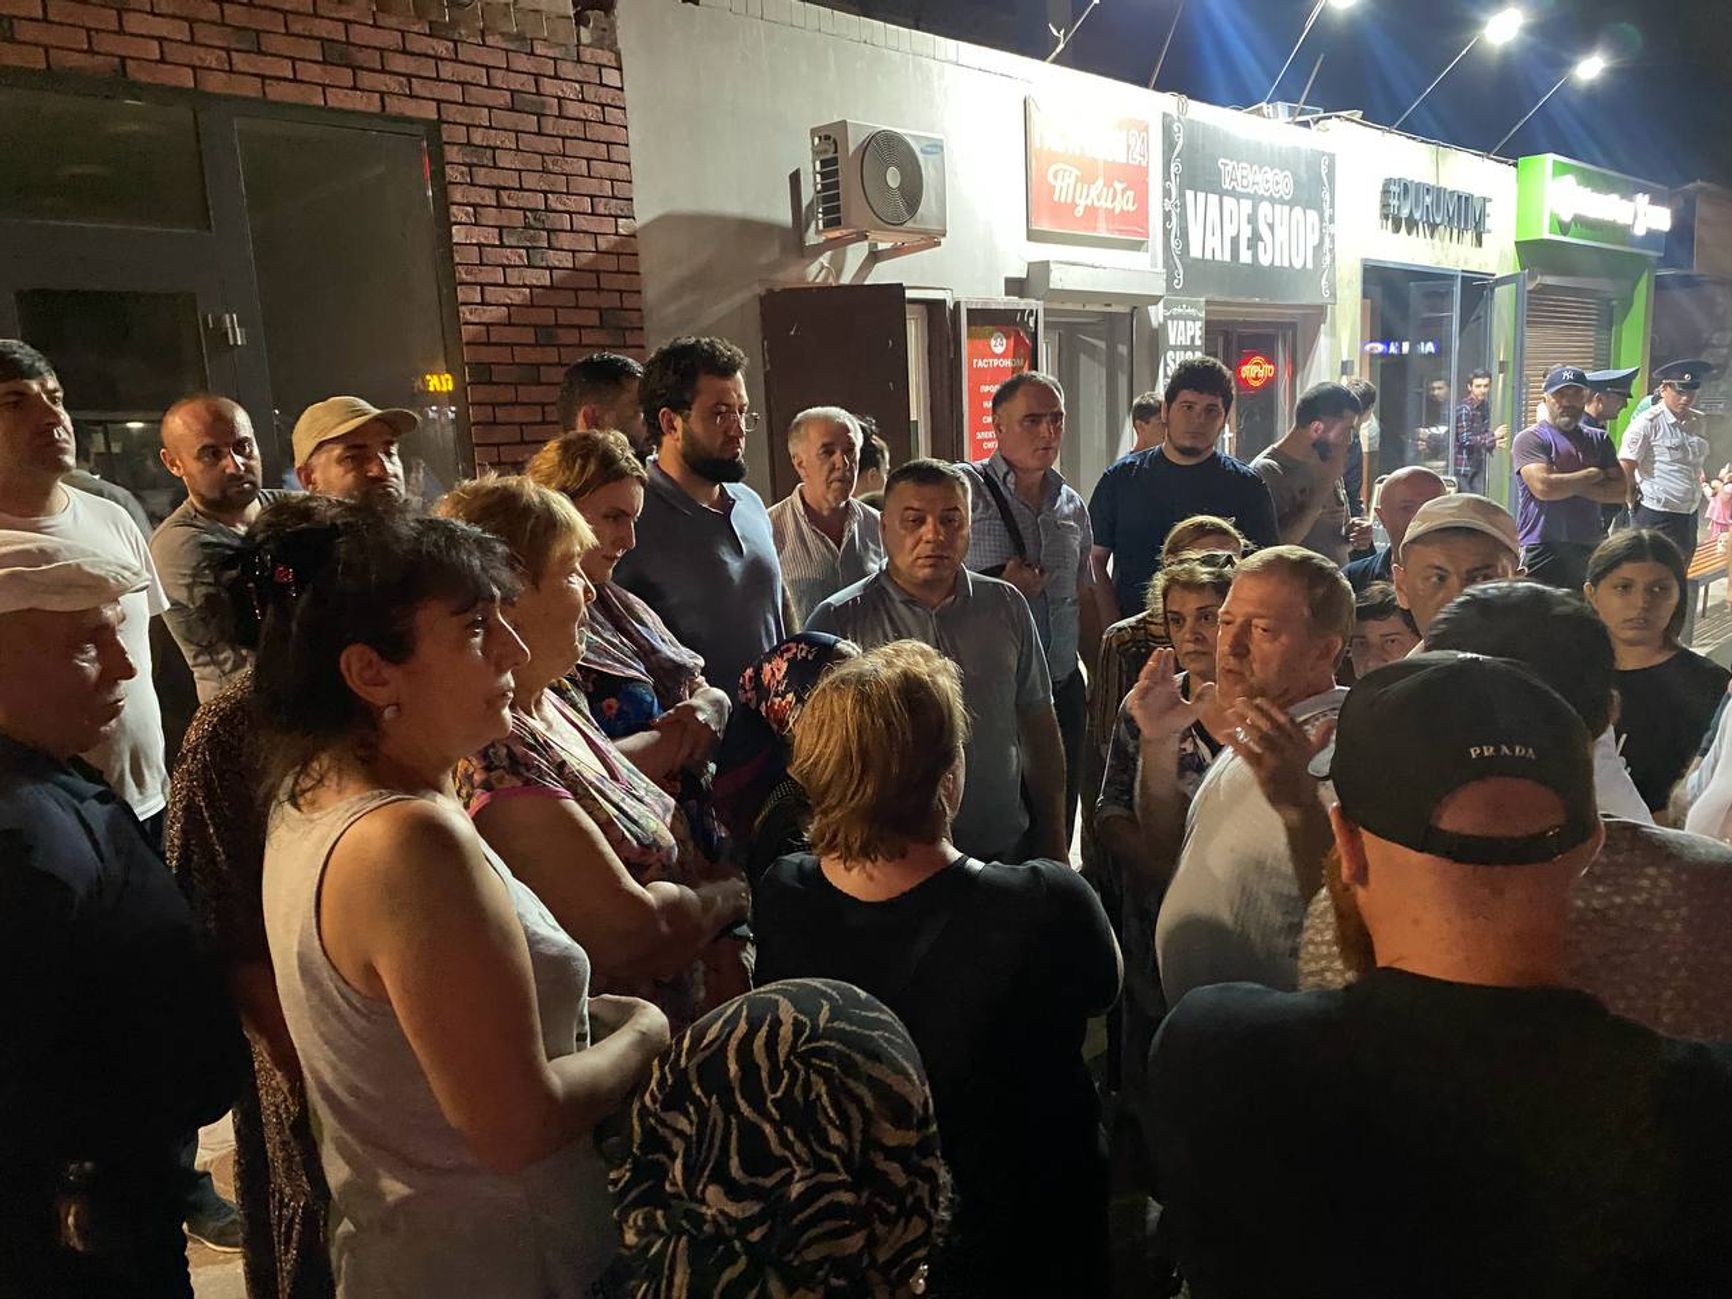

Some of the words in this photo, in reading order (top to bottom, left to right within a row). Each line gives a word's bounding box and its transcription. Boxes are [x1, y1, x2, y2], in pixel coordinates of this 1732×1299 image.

[1218, 158, 1293, 200] TABACCO
[1185, 189, 1252, 264] VAPE
[1258, 201, 1320, 269] SHOP
[1167, 320, 1202, 346] VAPE
[1470, 744, 1536, 759] PRADA
